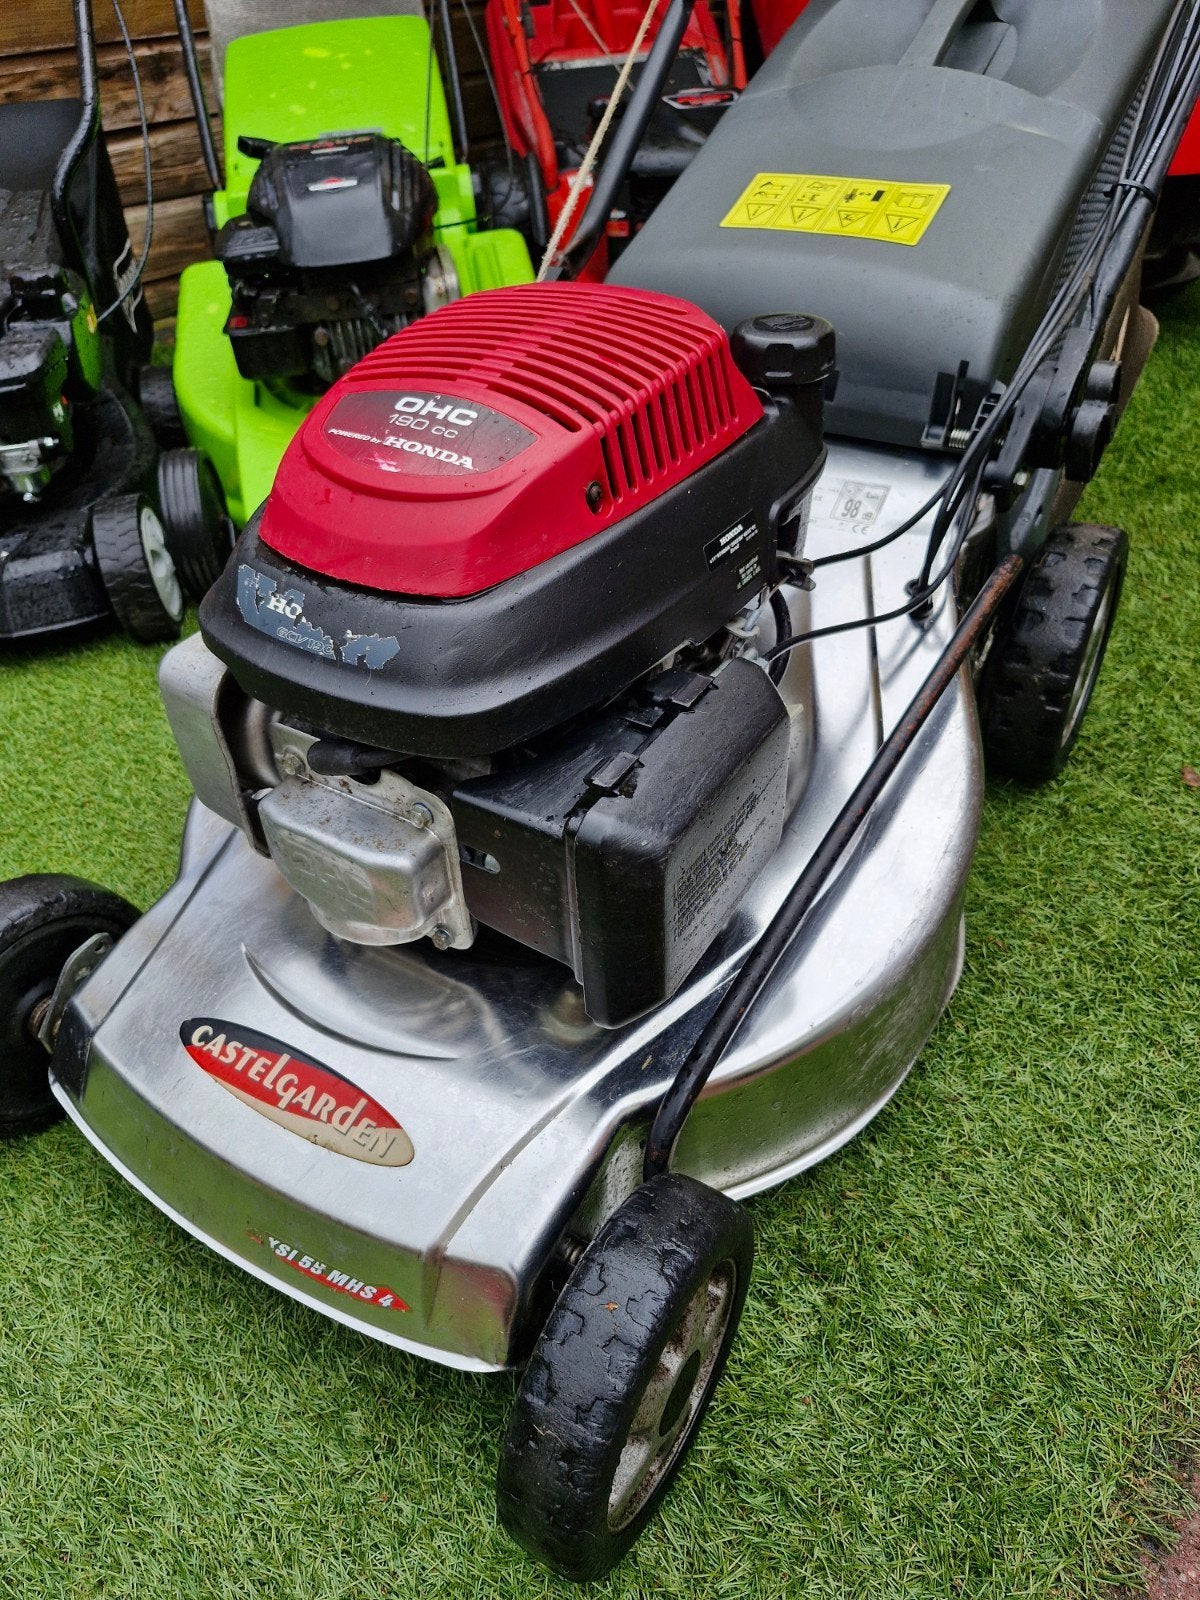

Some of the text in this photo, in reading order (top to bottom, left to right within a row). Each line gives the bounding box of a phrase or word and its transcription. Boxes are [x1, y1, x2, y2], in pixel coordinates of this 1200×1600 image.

[388, 413, 430, 431] 190
[394, 396, 478, 427] OHC
[328, 428, 371, 441] POWERED
[382, 436, 475, 470] HONDA
[841, 499, 862, 518] 98
[719, 523, 744, 546] HONDA
[326, 1269, 378, 1299] MHS
[378, 1294, 394, 1308] 4
